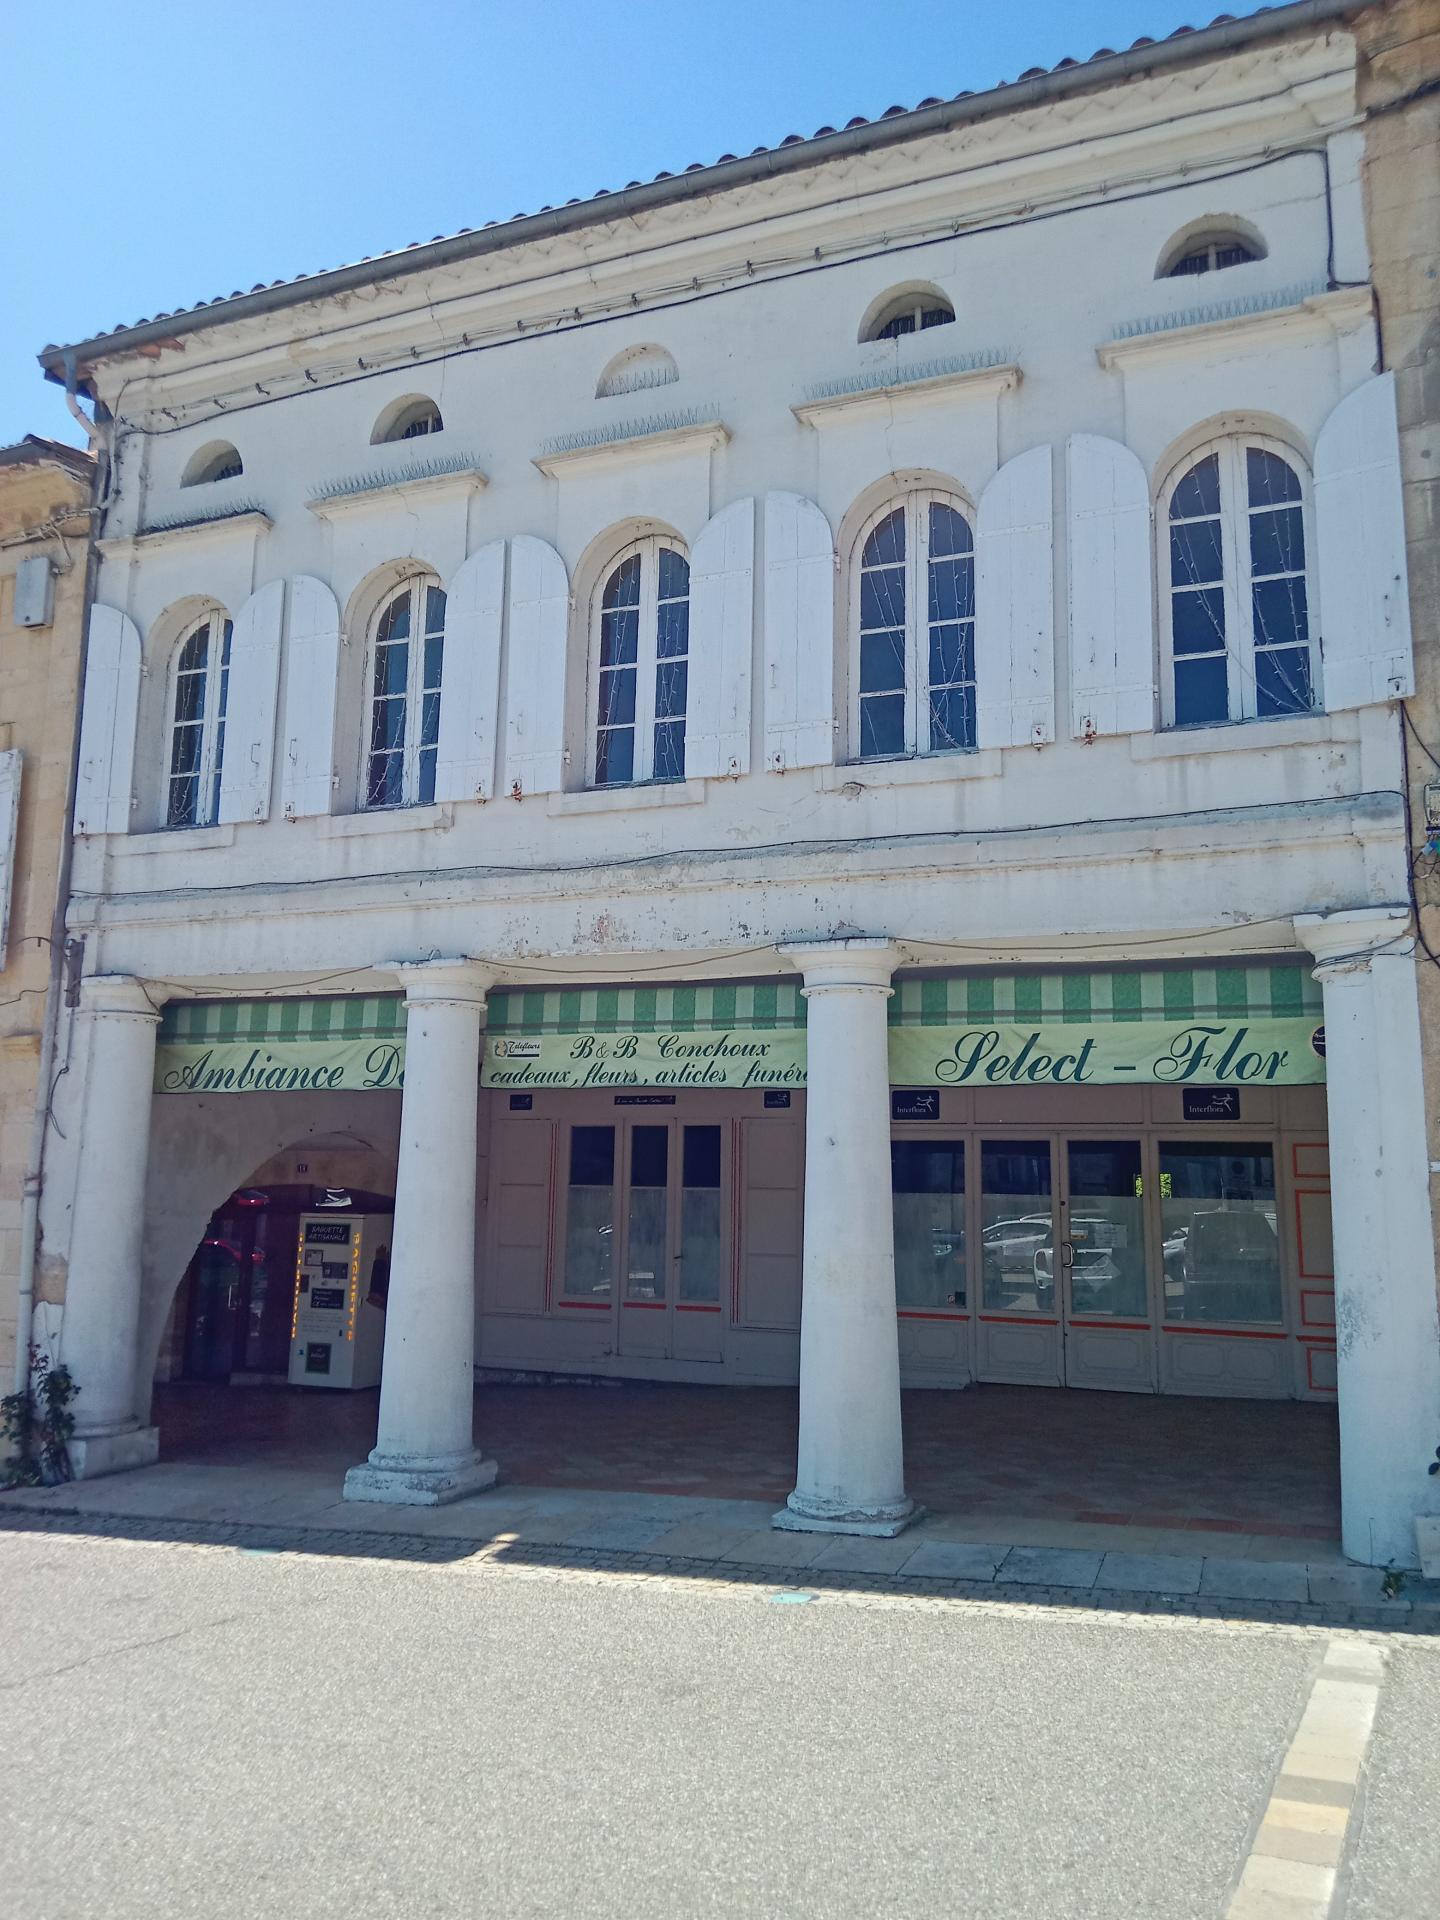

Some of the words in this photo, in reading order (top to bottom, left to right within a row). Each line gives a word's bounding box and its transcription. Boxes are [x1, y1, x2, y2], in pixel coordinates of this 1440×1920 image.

[657, 1034, 771, 1059] Conchoux
[935, 1031, 1098, 1082] Select
[1152, 1026, 1289, 1081] Flor
[164, 1049, 344, 1089] Ambiance
[655, 1060, 727, 1083] articles
[1189, 1105, 1224, 1113] Interflora
